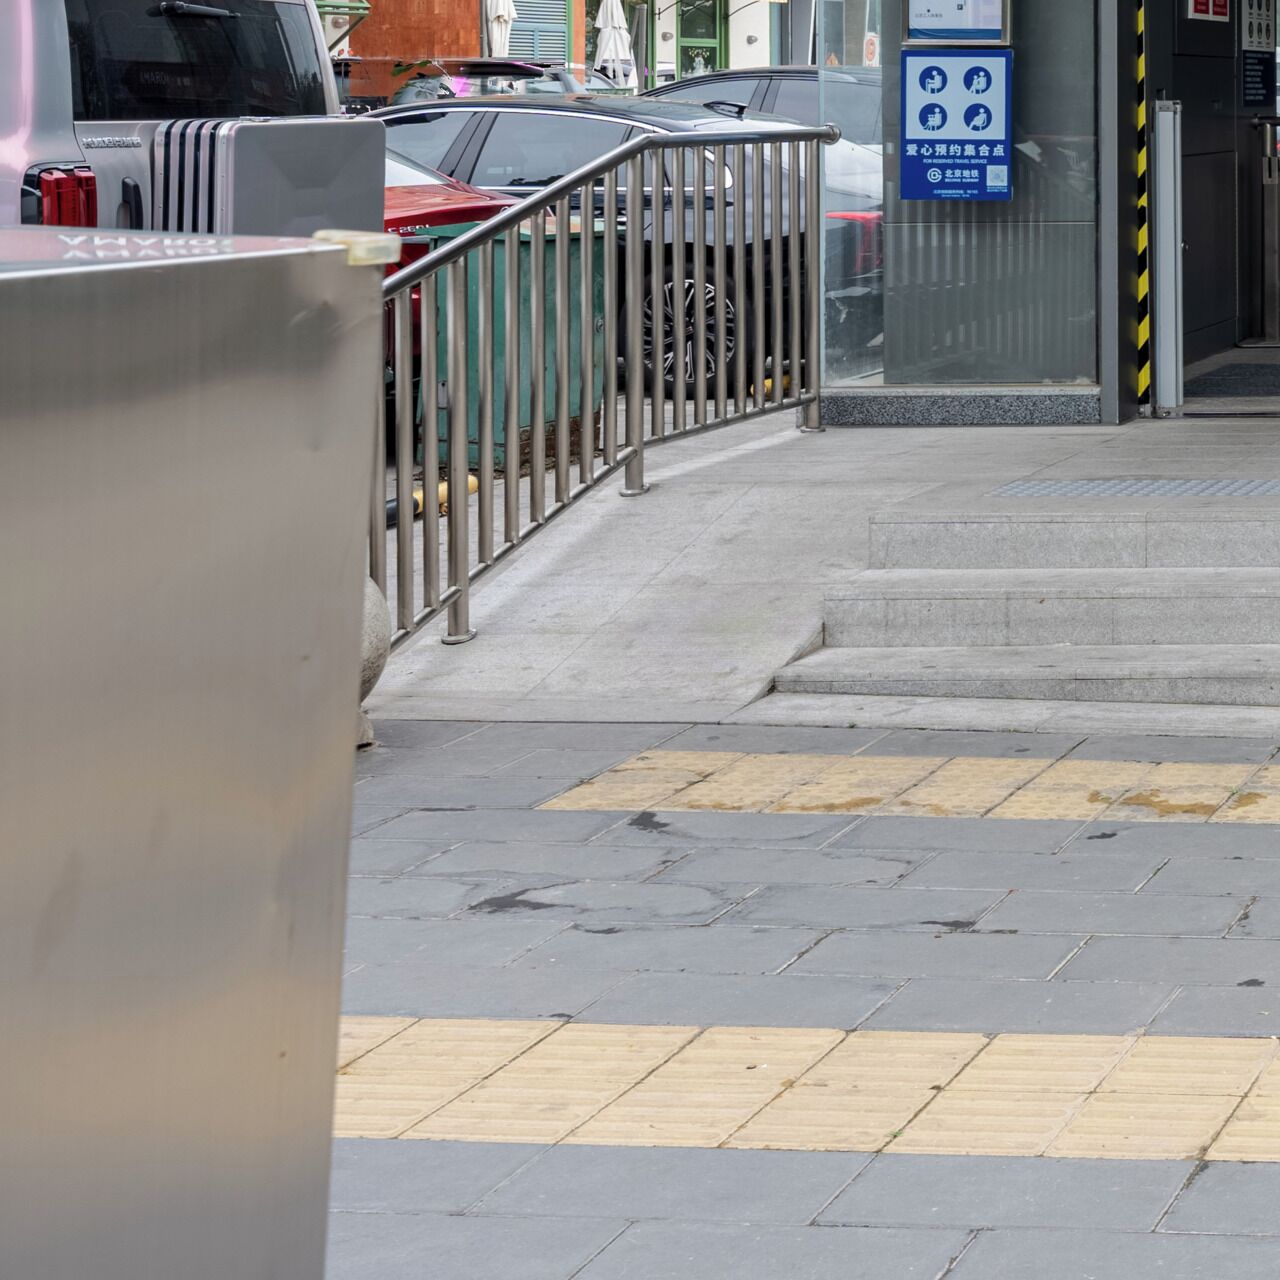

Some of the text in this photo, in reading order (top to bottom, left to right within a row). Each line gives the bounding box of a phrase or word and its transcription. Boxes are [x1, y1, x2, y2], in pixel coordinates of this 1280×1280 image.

[905, 143, 1005, 157] 爱心预约集合点
[944, 168, 979, 178] 北京地铁
